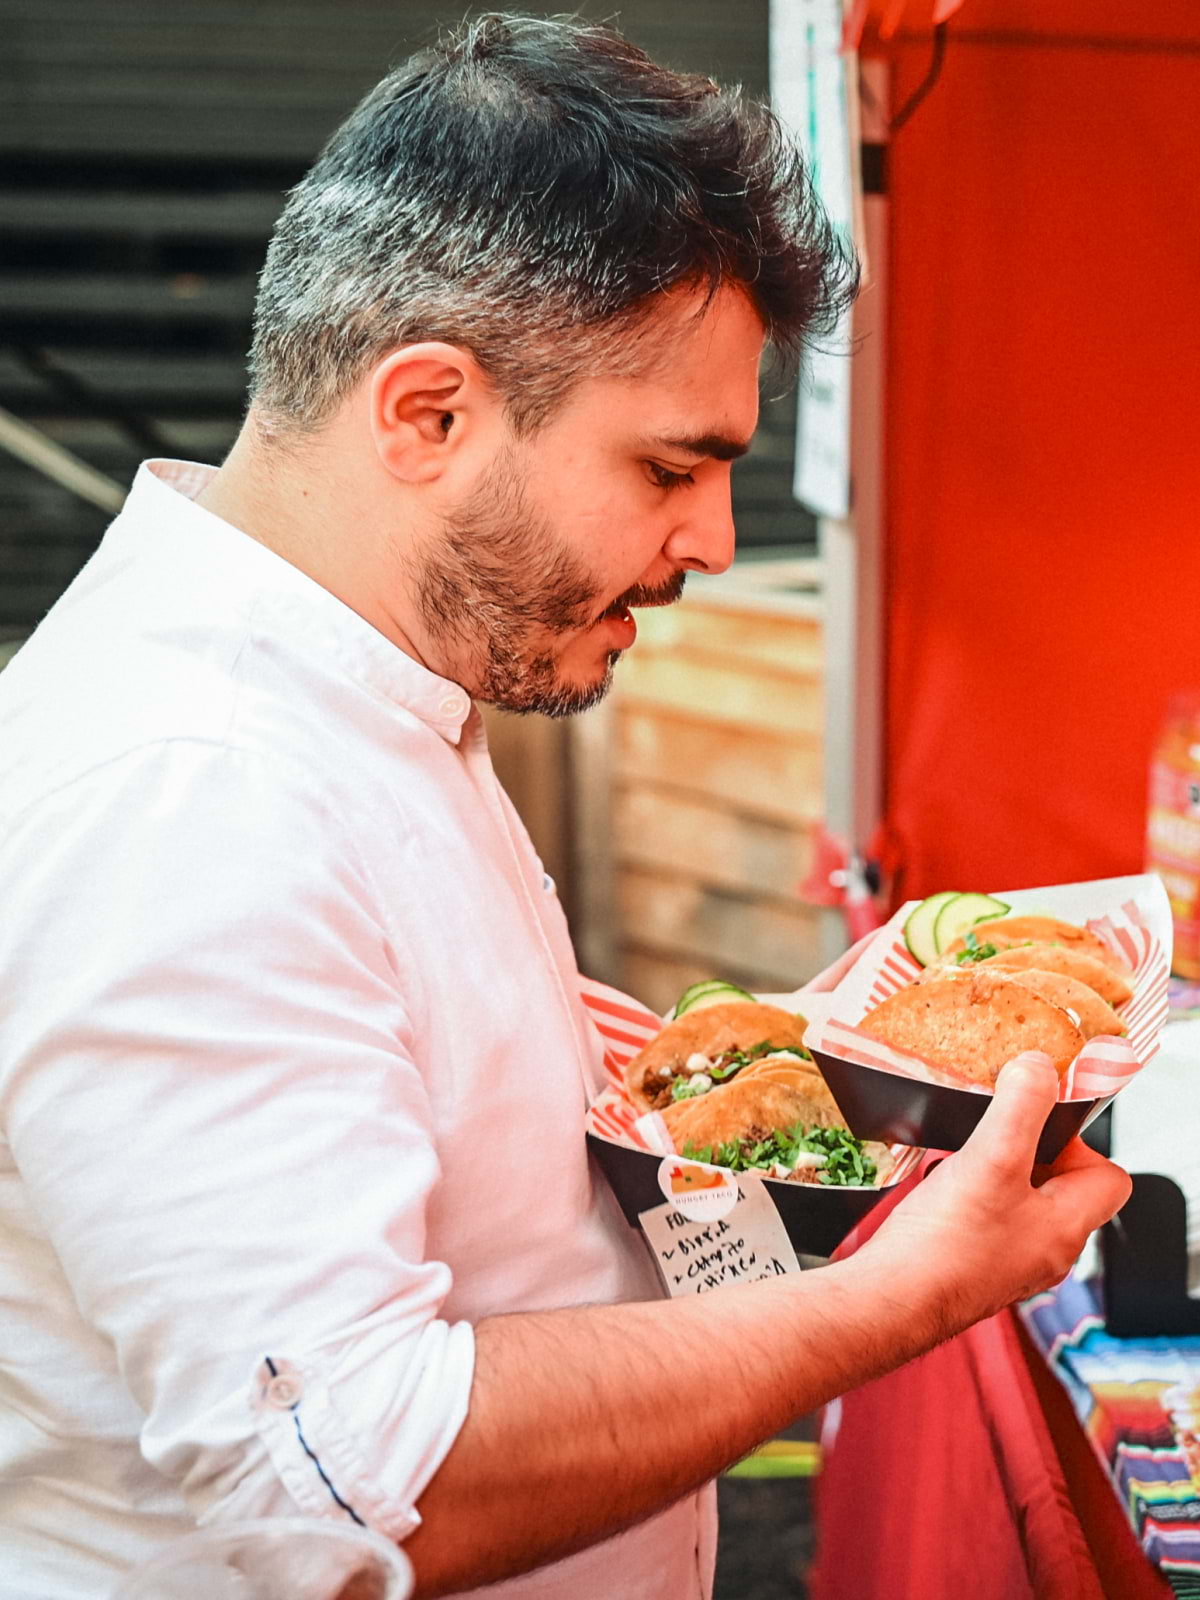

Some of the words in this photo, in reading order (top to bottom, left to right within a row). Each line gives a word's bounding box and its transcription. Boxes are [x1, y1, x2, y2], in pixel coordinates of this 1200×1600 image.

[675, 1194, 708, 1204] HUNGRY
[712, 1191, 733, 1199] TACO
[665, 1211, 691, 1230] FO
